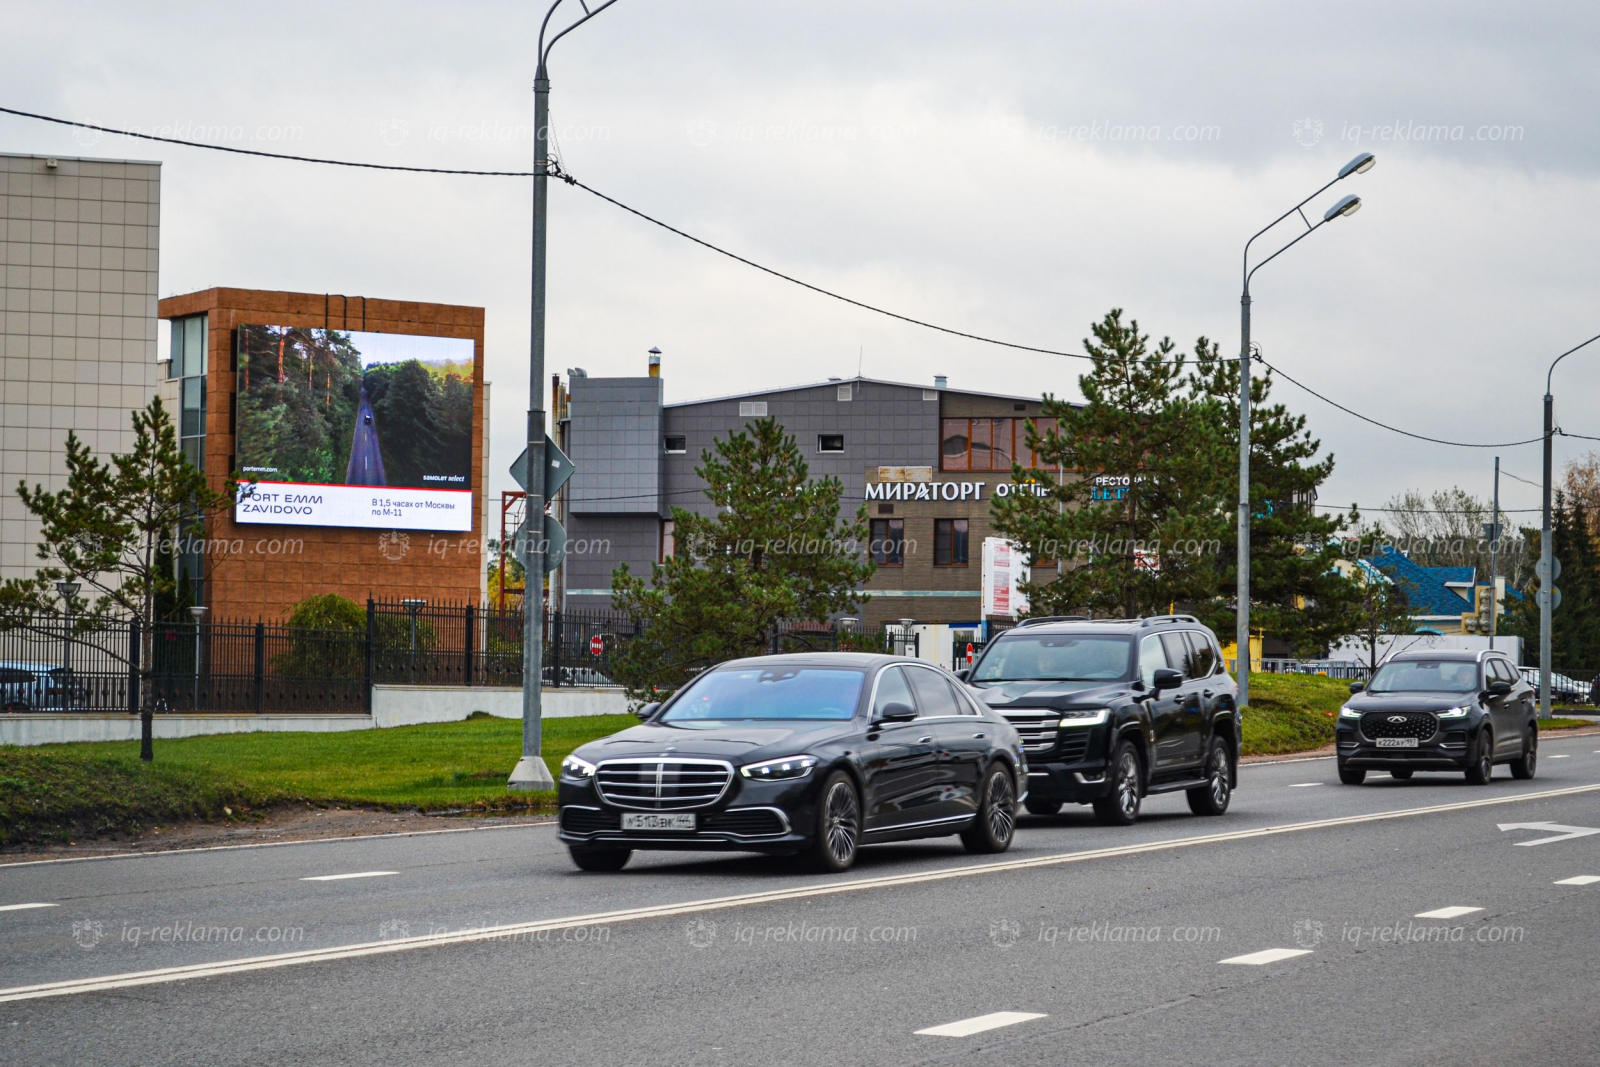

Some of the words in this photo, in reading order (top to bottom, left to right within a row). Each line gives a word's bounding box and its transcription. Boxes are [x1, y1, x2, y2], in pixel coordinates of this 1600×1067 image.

[865, 481, 986, 501] МИРАТОРГ
[243, 492, 279, 502] ORT
[284, 494, 323, 504] EMM
[243, 504, 313, 515] ZAVIDOVO
[372, 499, 378, 507] В
[380, 499, 391, 508] 1,5
[425, 501, 455, 510] Москвы
[383, 509, 402, 517] М-11
